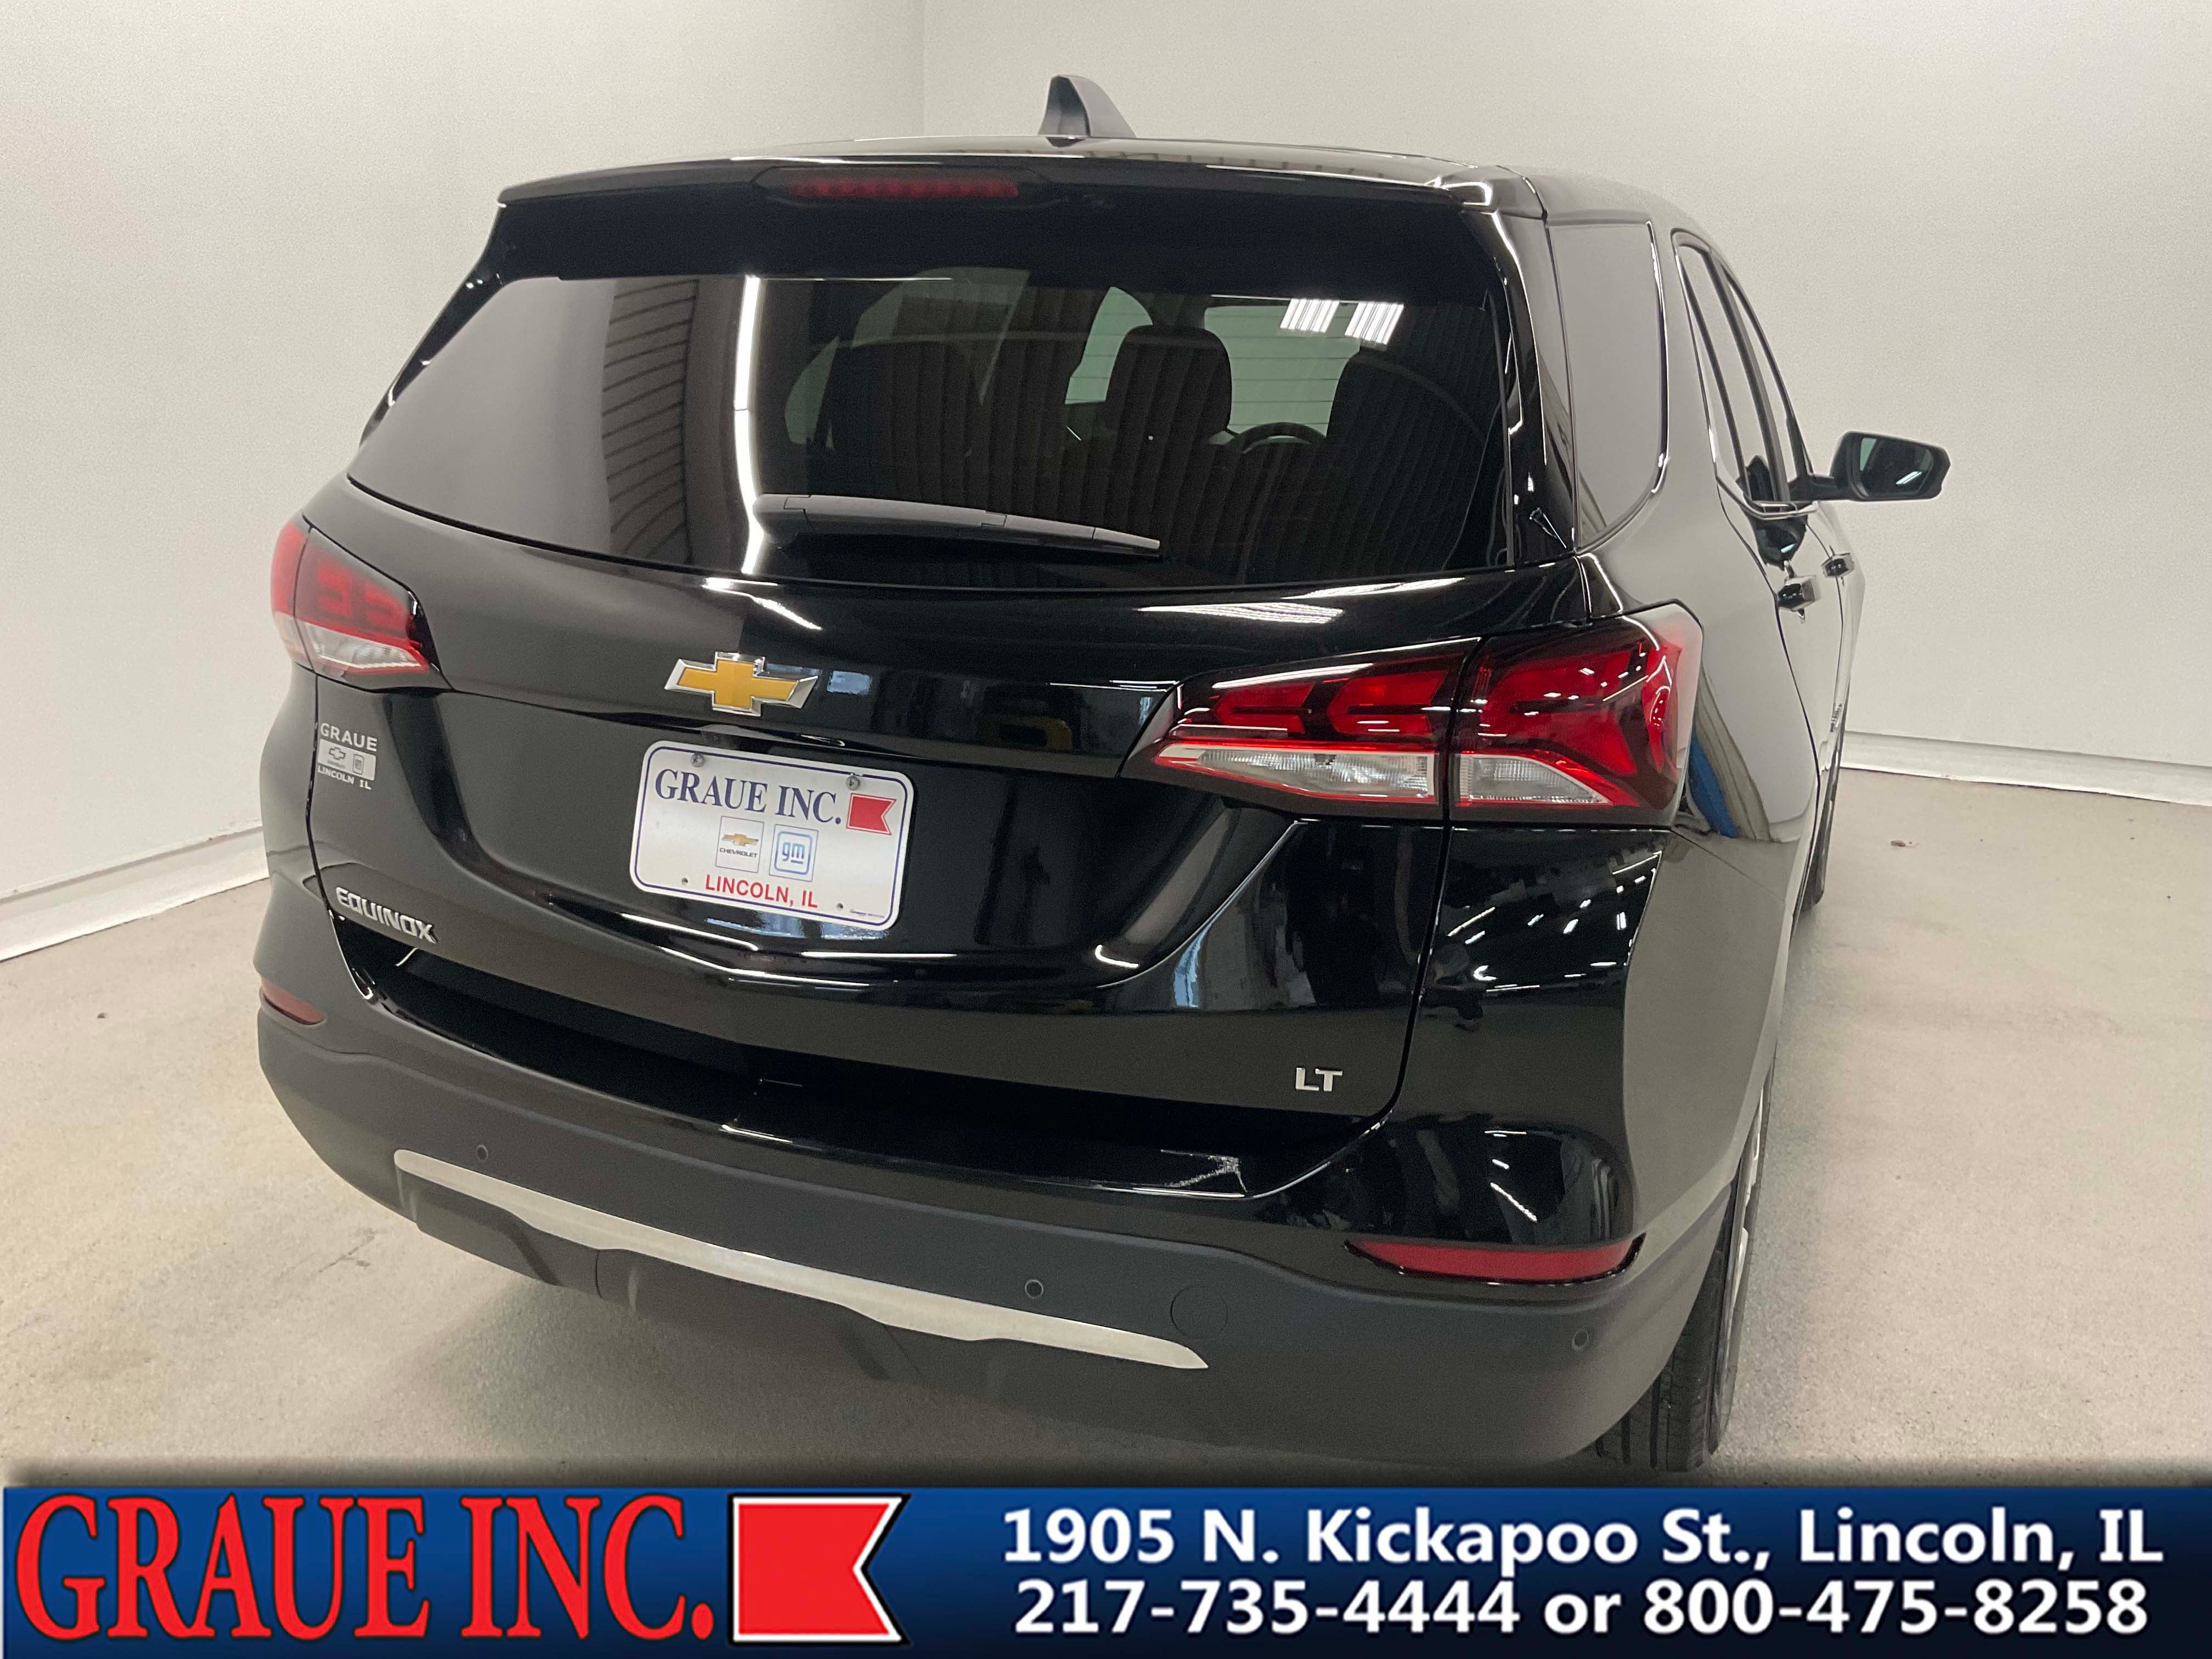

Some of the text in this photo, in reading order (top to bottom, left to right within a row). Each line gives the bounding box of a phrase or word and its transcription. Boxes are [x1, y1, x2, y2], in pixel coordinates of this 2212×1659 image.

[320, 723, 377, 752] GRAUE
[318, 766, 371, 790] LINCOLN IL
[655, 769, 841, 825] GRAUE INC.
[719, 848, 758, 858] CHEVROLET
[782, 842, 805, 862] gm
[706, 874, 818, 908] LINCOLN, IL
[336, 887, 438, 944] EQUINOX
[1295, 1067, 1343, 1092] LT
